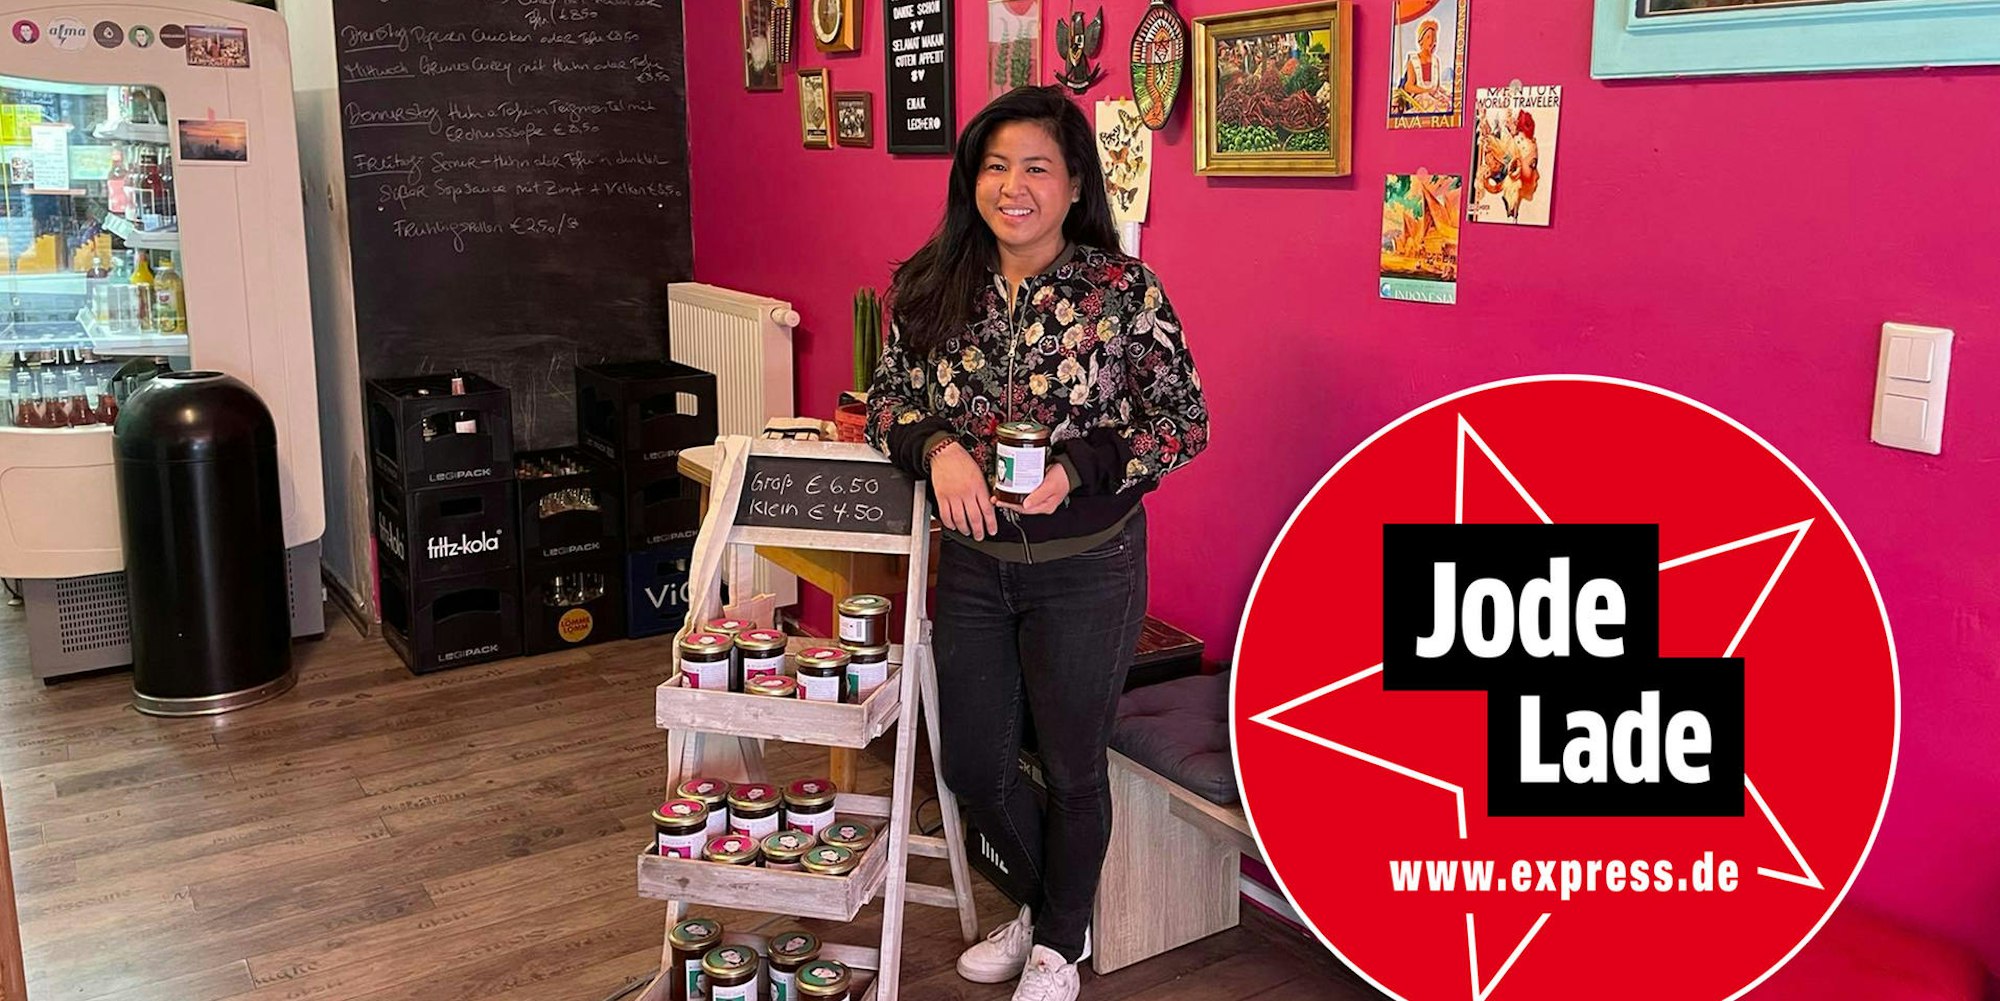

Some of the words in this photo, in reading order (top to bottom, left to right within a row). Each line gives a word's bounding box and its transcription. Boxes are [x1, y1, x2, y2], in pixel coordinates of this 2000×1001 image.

[1513, 95, 1559, 109] TRAVELER
[429, 467, 492, 482] LEGIPACK
[427, 530, 500, 559] fritz-kola
[543, 542, 601, 558] LEGIPACK
[438, 643, 499, 662] LEGIPACK
